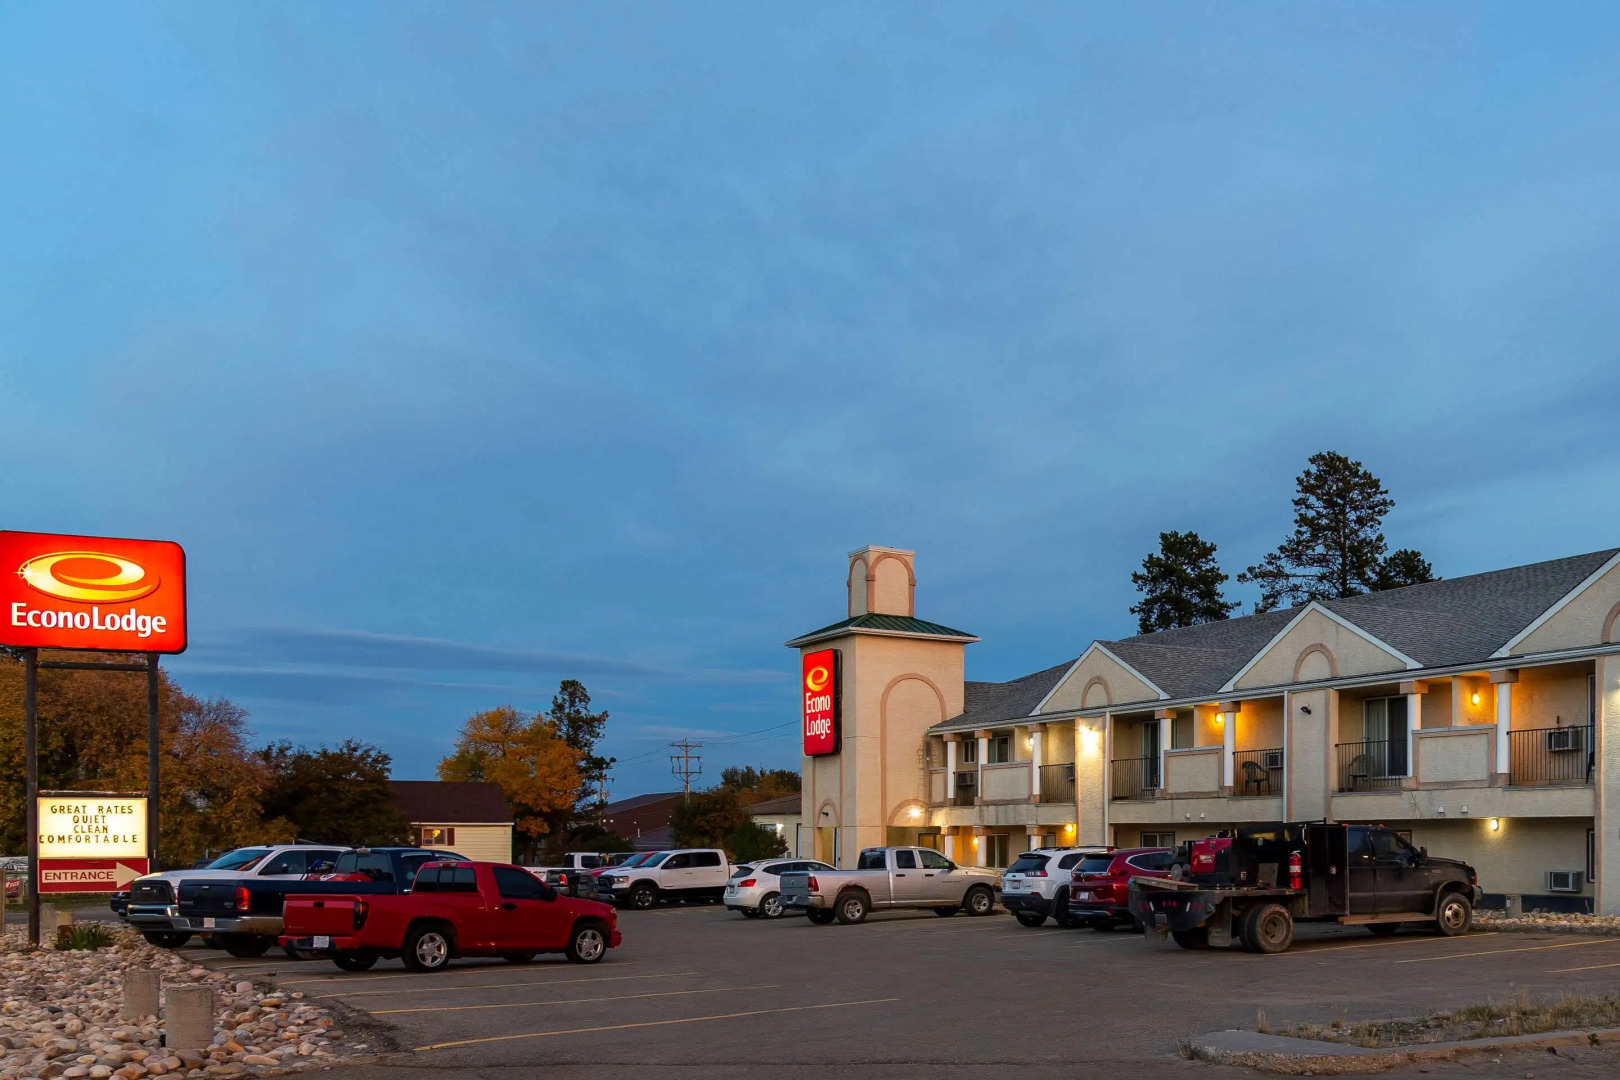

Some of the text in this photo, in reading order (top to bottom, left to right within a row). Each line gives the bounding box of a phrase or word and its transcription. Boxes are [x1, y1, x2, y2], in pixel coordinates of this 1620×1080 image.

[11, 602, 167, 638] EconoLodge
[806, 692, 831, 714] Econo
[806, 714, 831, 740] Lodge
[50, 805, 133, 814] GREAT RATES
[72, 815, 106, 824] QUIET
[73, 825, 109, 834] CLEAN
[38, 834, 138, 844] COMFORTABLE
[44, 871, 114, 881] ENTRANCE
